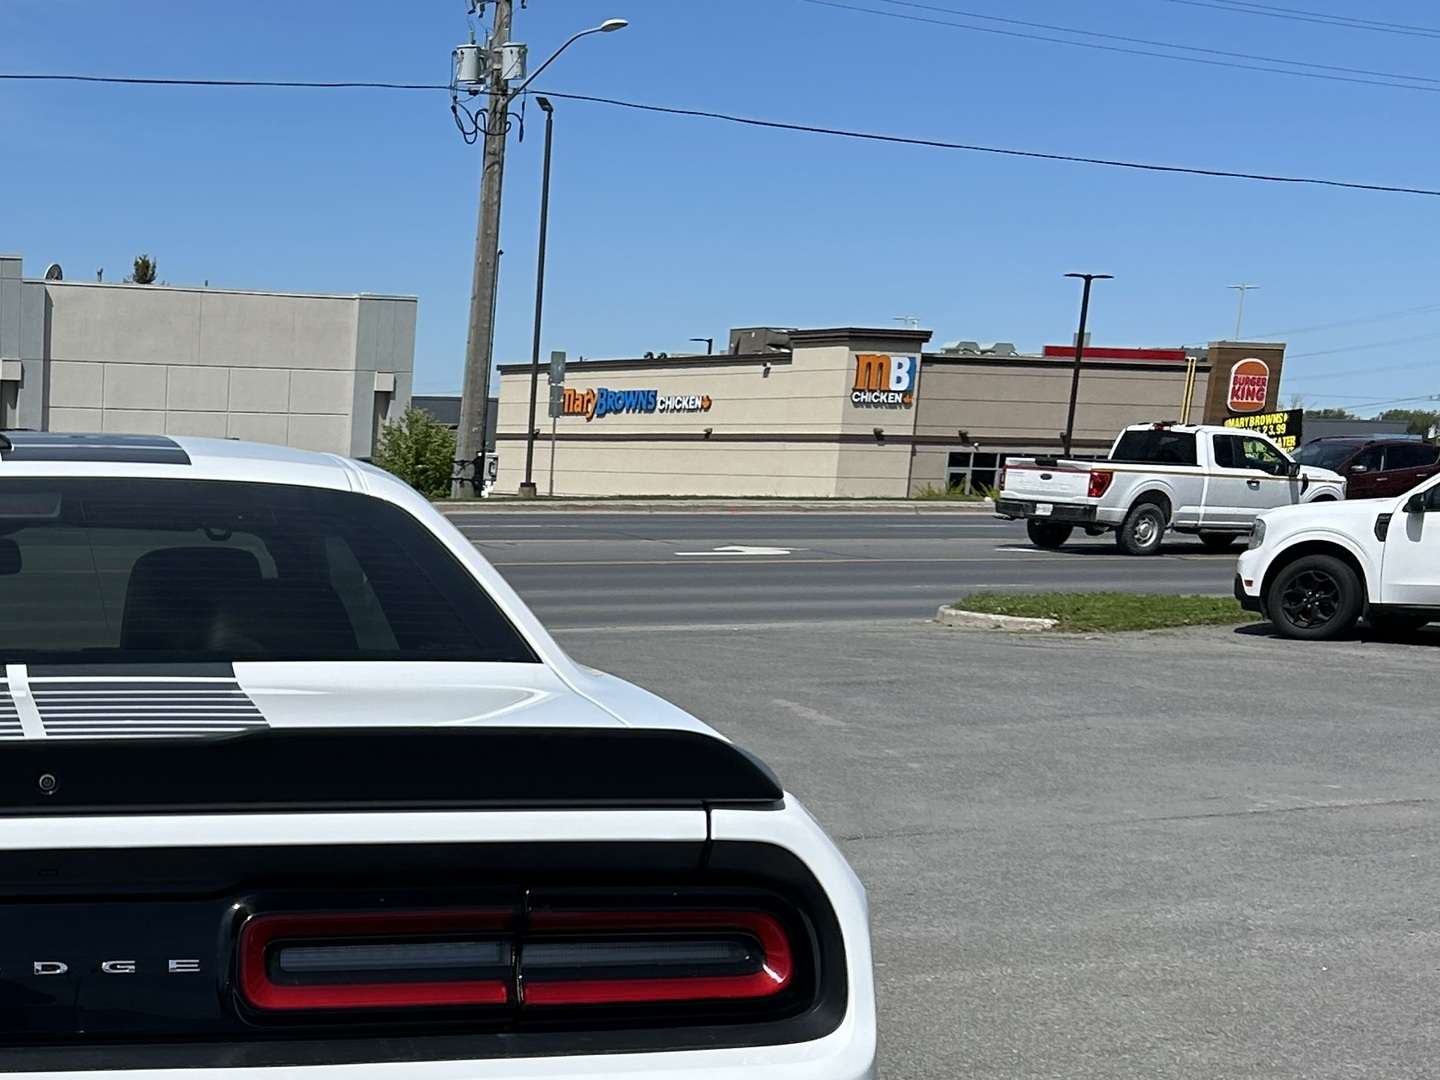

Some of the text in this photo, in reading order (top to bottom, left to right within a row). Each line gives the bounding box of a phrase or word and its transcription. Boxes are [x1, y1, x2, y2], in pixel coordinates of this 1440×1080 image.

[1233, 375, 1267, 387] BURGER
[852, 391, 903, 403] CHICKEN
[1231, 386, 1266, 401] KING
[596, 388, 658, 416] BROWNS
[658, 395, 703, 410] CHICKEN
